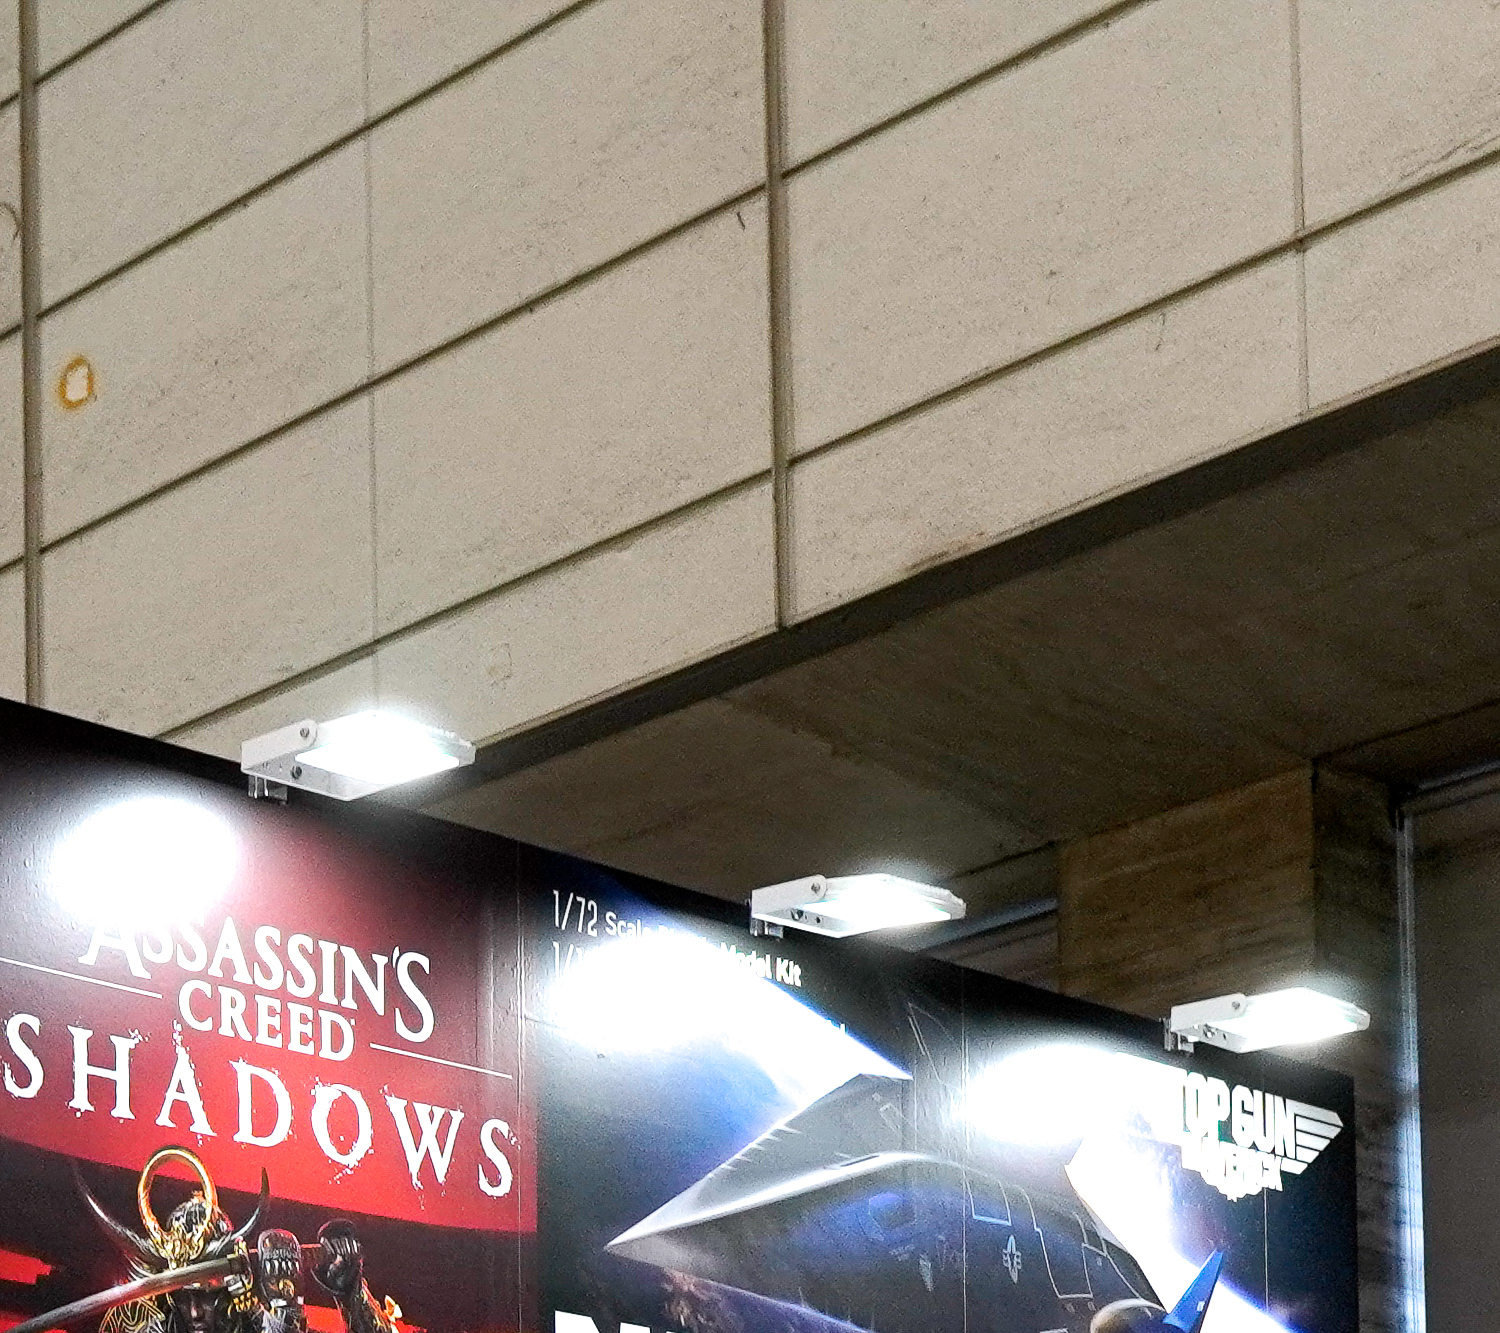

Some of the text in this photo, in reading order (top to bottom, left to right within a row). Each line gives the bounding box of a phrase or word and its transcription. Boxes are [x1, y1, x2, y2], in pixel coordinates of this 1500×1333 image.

[553, 889, 598, 937] 1/72
[776, 956, 802, 987] Kit
[179, 979, 356, 1063] CREED
[1231, 1084, 1296, 1161] GUN
